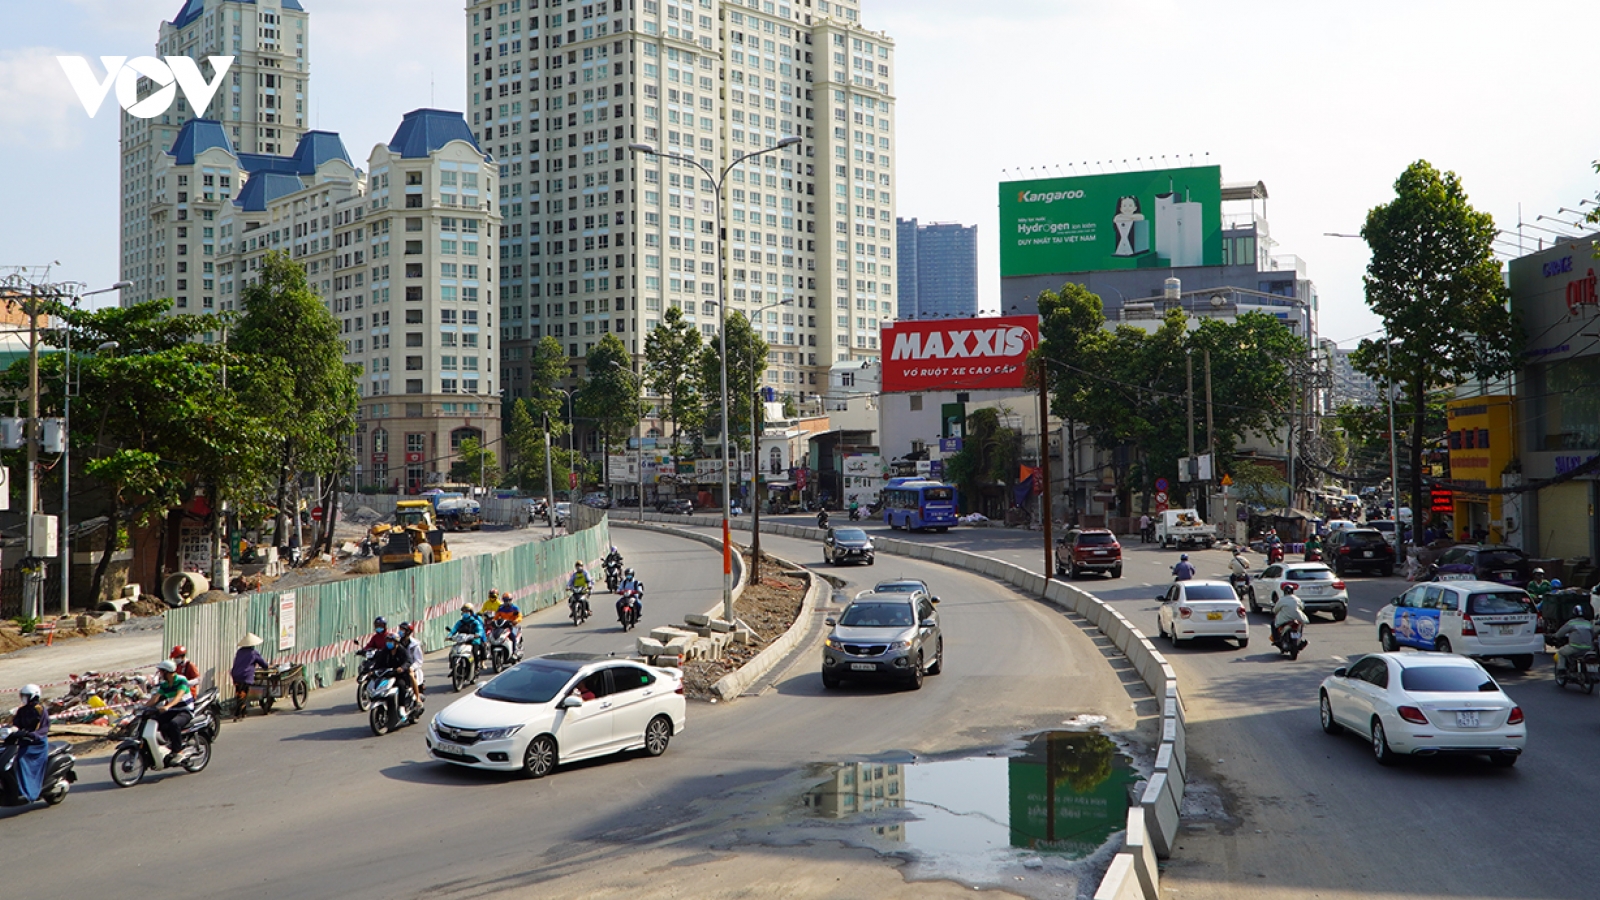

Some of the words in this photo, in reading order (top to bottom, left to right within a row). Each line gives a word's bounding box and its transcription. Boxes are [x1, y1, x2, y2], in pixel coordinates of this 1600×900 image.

[1018, 190, 1085, 203] Kangaroo
[1018, 223, 1070, 235] Hydrogen
[890, 327, 1025, 360] MAXXIS
[904, 367, 918, 376] VỎ
[920, 366, 949, 377] RUỘT
[952, 366, 966, 375] XE
[969, 365, 992, 374] CAO
